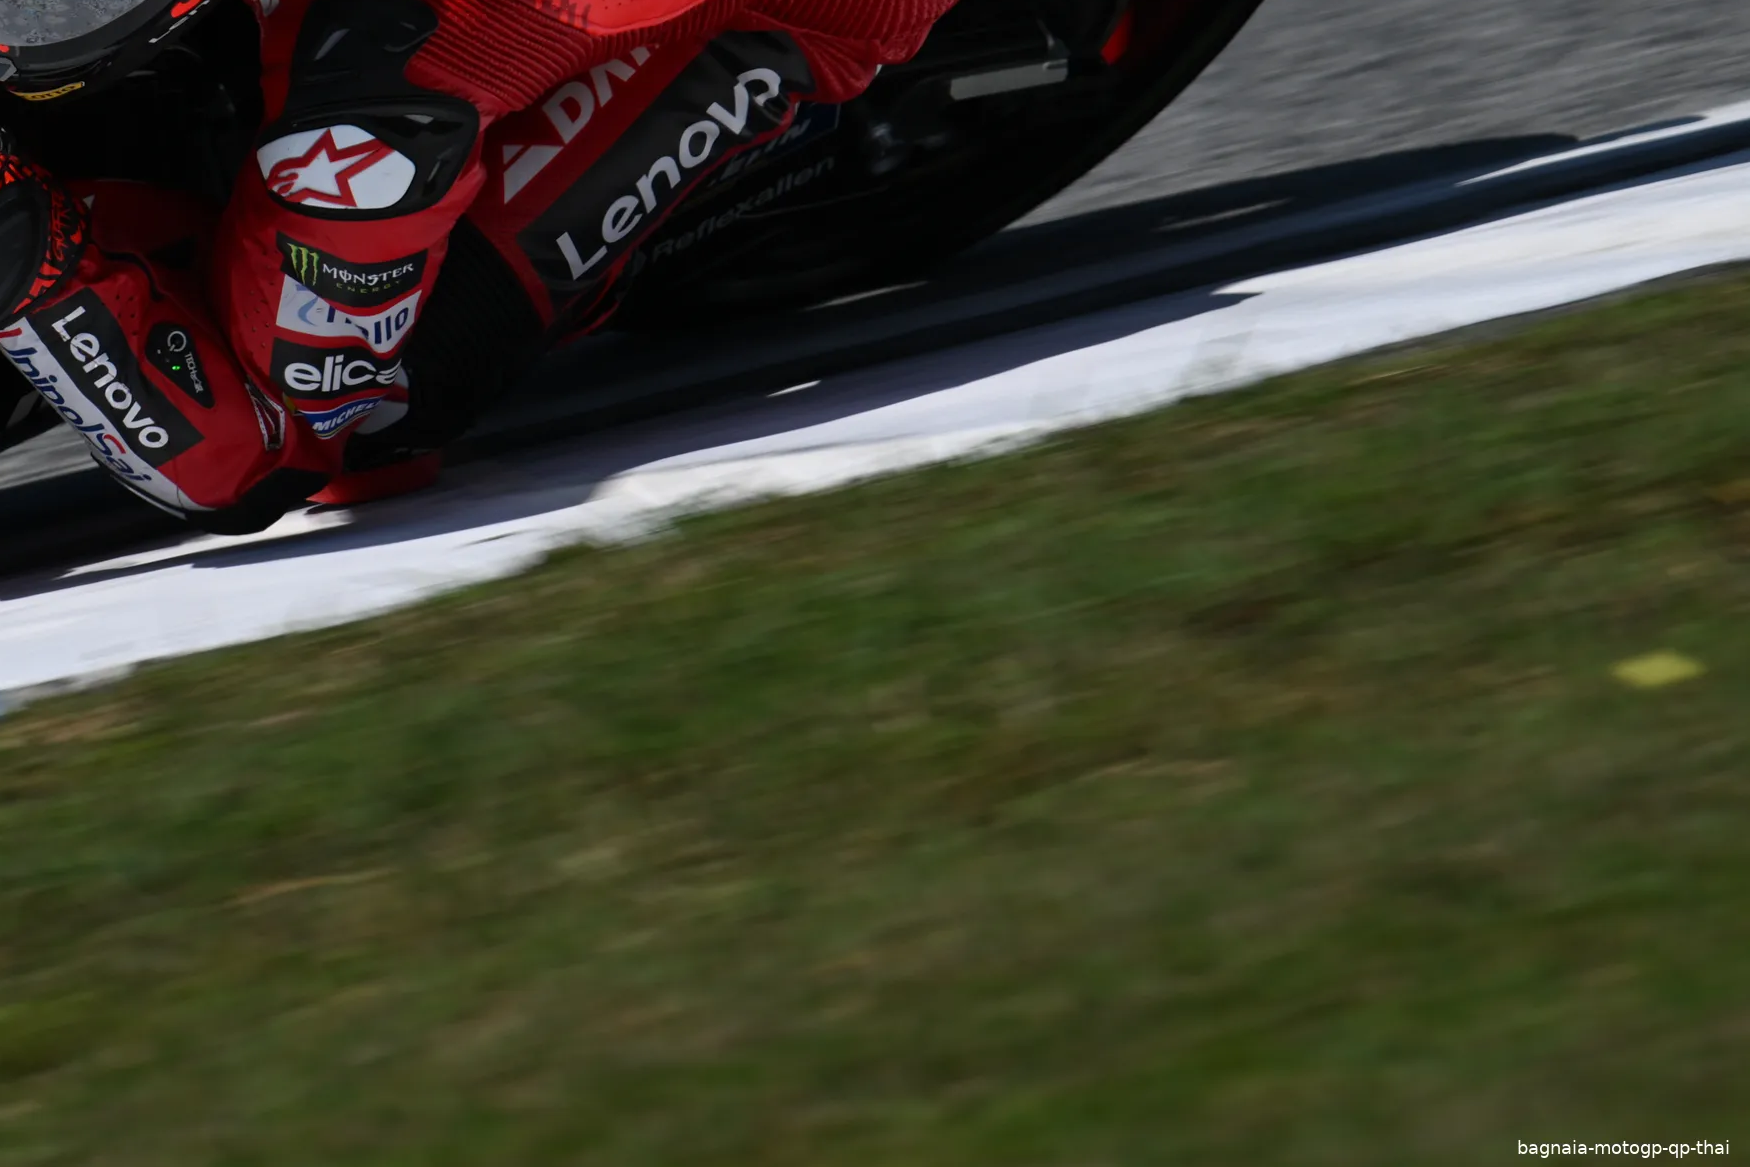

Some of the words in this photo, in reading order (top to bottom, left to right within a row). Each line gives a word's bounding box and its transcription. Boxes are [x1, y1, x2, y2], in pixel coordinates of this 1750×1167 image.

[556, 67, 782, 281] Lenovo
[322, 262, 415, 286] MONSTER
[51, 306, 169, 449] Lenovo
